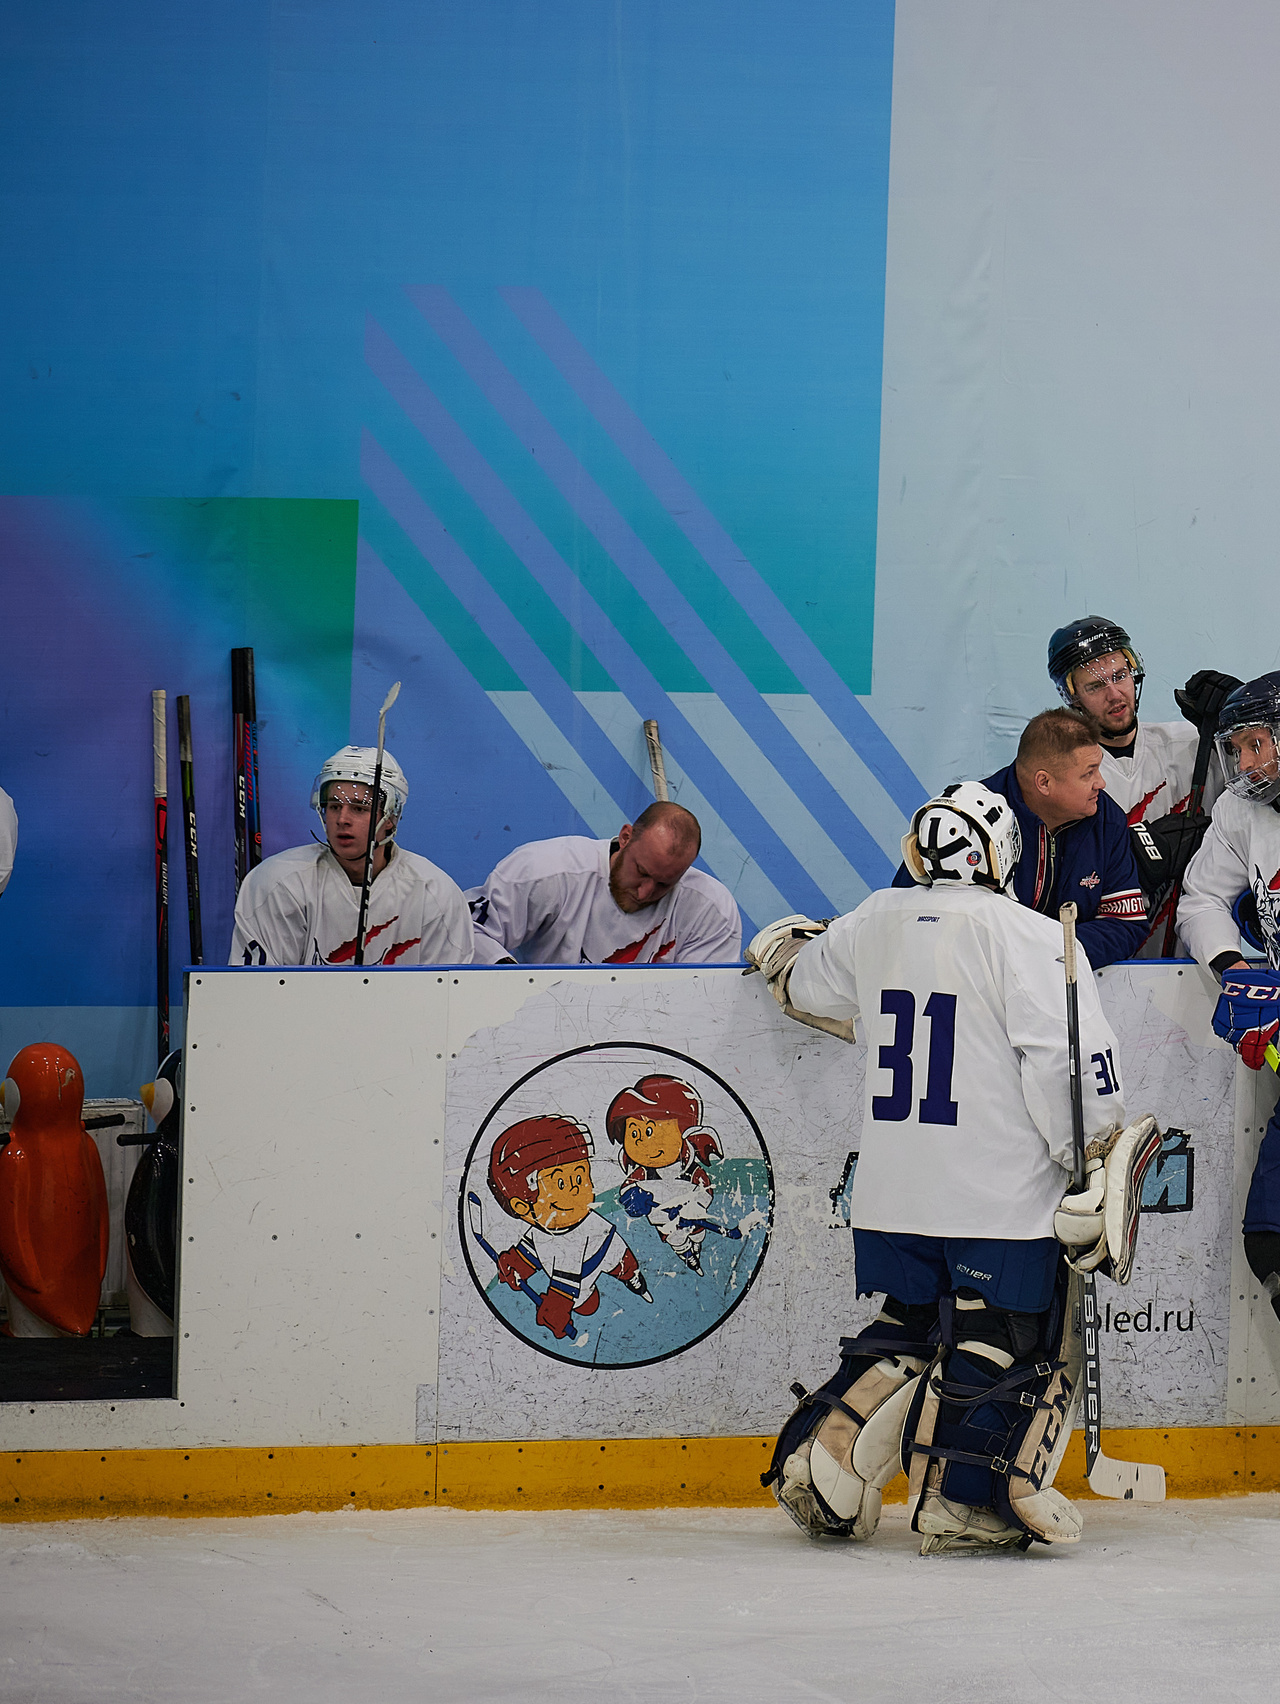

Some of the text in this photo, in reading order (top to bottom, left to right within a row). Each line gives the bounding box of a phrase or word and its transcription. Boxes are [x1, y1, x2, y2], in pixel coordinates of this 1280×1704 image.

[189, 811, 198, 858] CCM
[161, 862, 169, 904] BAUER
[872, 989, 959, 1126] 31
[1091, 1048, 1120, 1096] 31
[956, 1263, 993, 1281] BAUER
[1084, 1294, 1099, 1453] BAUER
[1026, 1372, 1074, 1492] CCM
